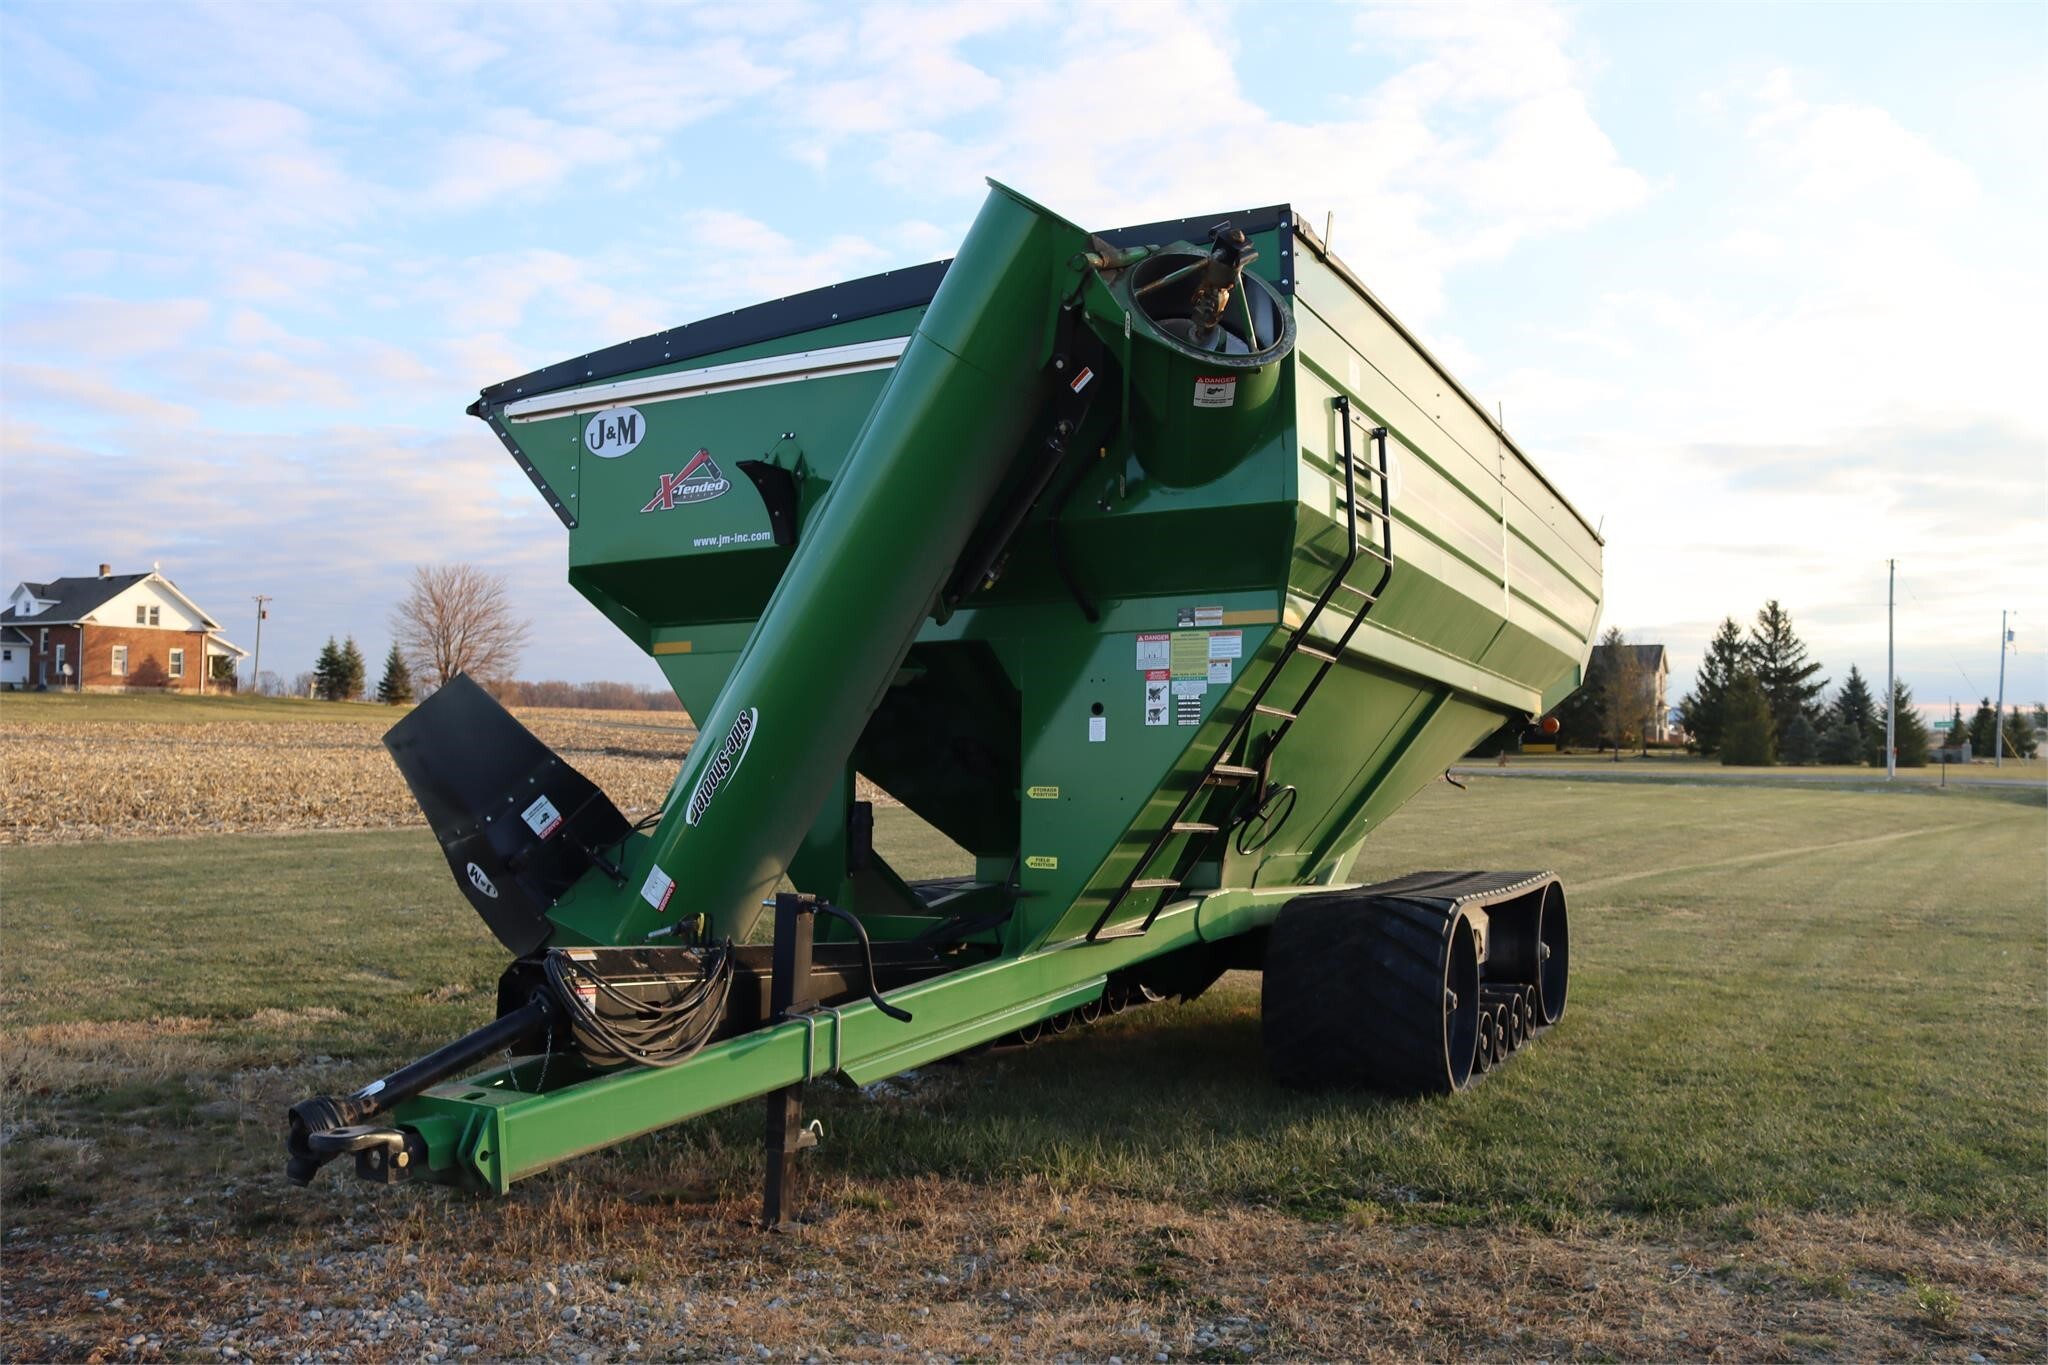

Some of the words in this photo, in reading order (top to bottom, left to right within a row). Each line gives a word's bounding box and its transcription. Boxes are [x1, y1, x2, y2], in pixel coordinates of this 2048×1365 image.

[1204, 376, 1236, 384] DANGER
[589, 413, 638, 450] J&M
[693, 531, 771, 547] www.jm-inc.com
[1144, 633, 1169, 641] DANGER
[691, 711, 752, 828] Side-Shooter
